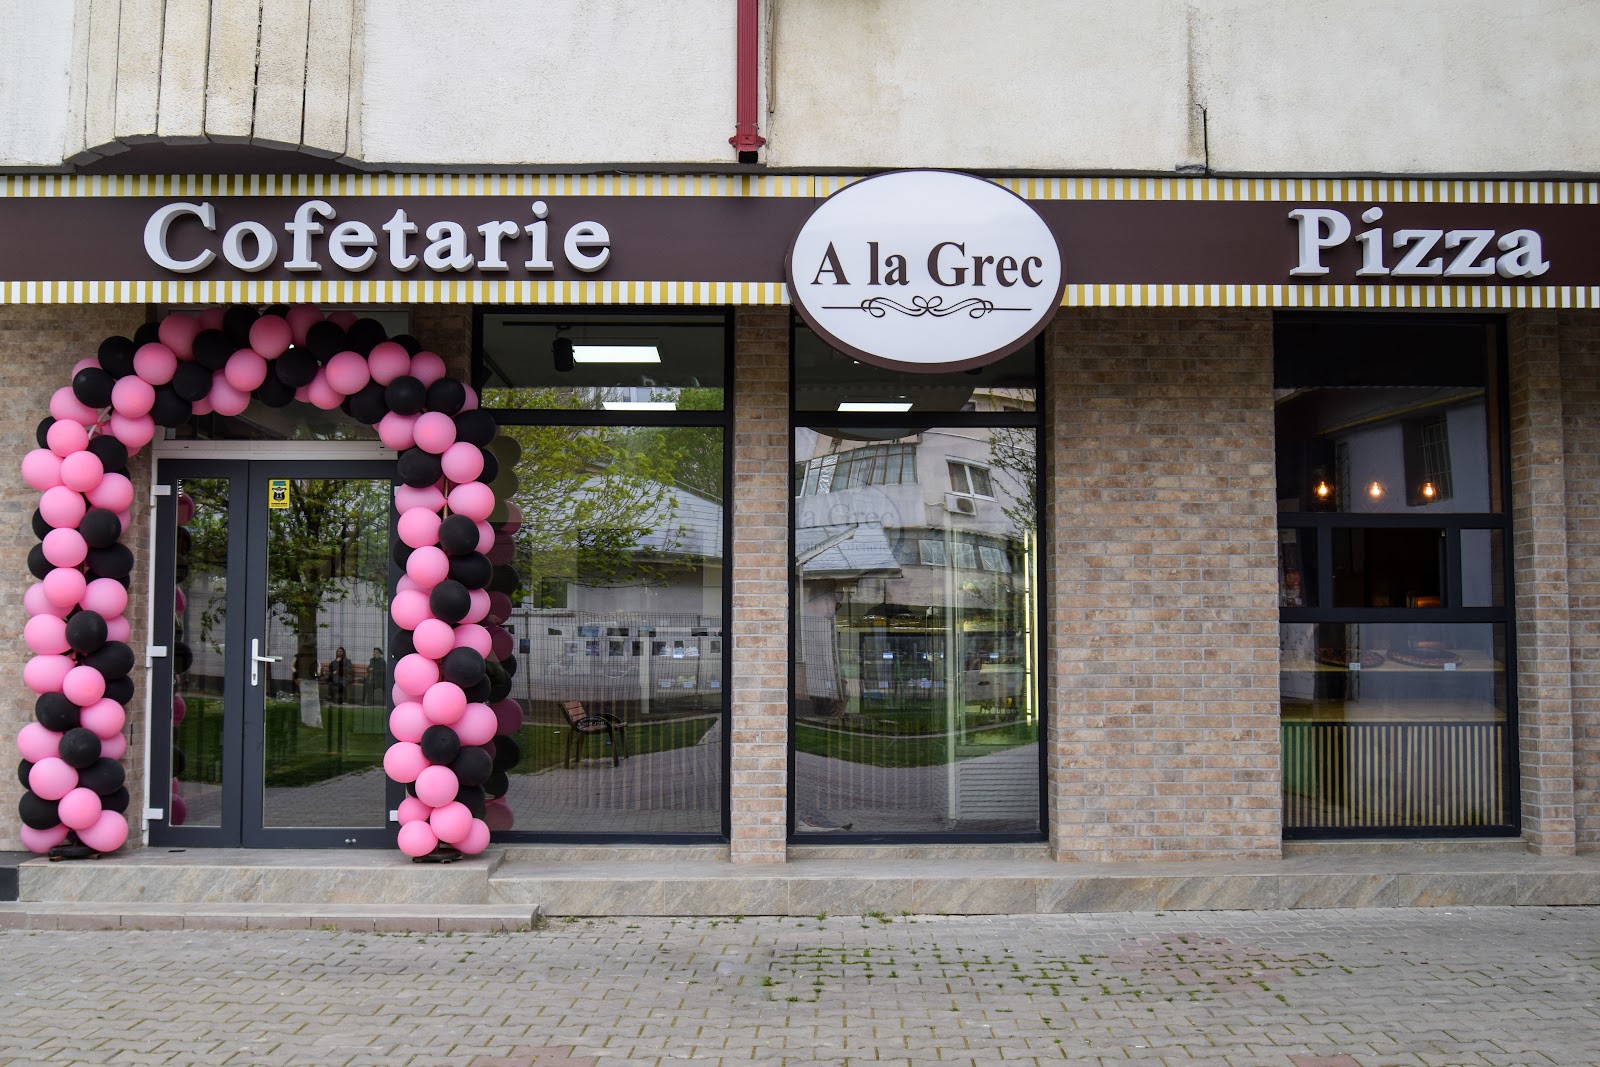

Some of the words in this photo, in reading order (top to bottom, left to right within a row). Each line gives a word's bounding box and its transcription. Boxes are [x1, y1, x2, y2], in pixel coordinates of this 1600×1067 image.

[143, 200, 610, 272] Cofetarie
[811, 242, 850, 286] A
[867, 242, 909, 286] la
[928, 241, 1043, 287] Grec
[1288, 206, 1550, 278] Pizza
[828, 503, 895, 529] Grec
